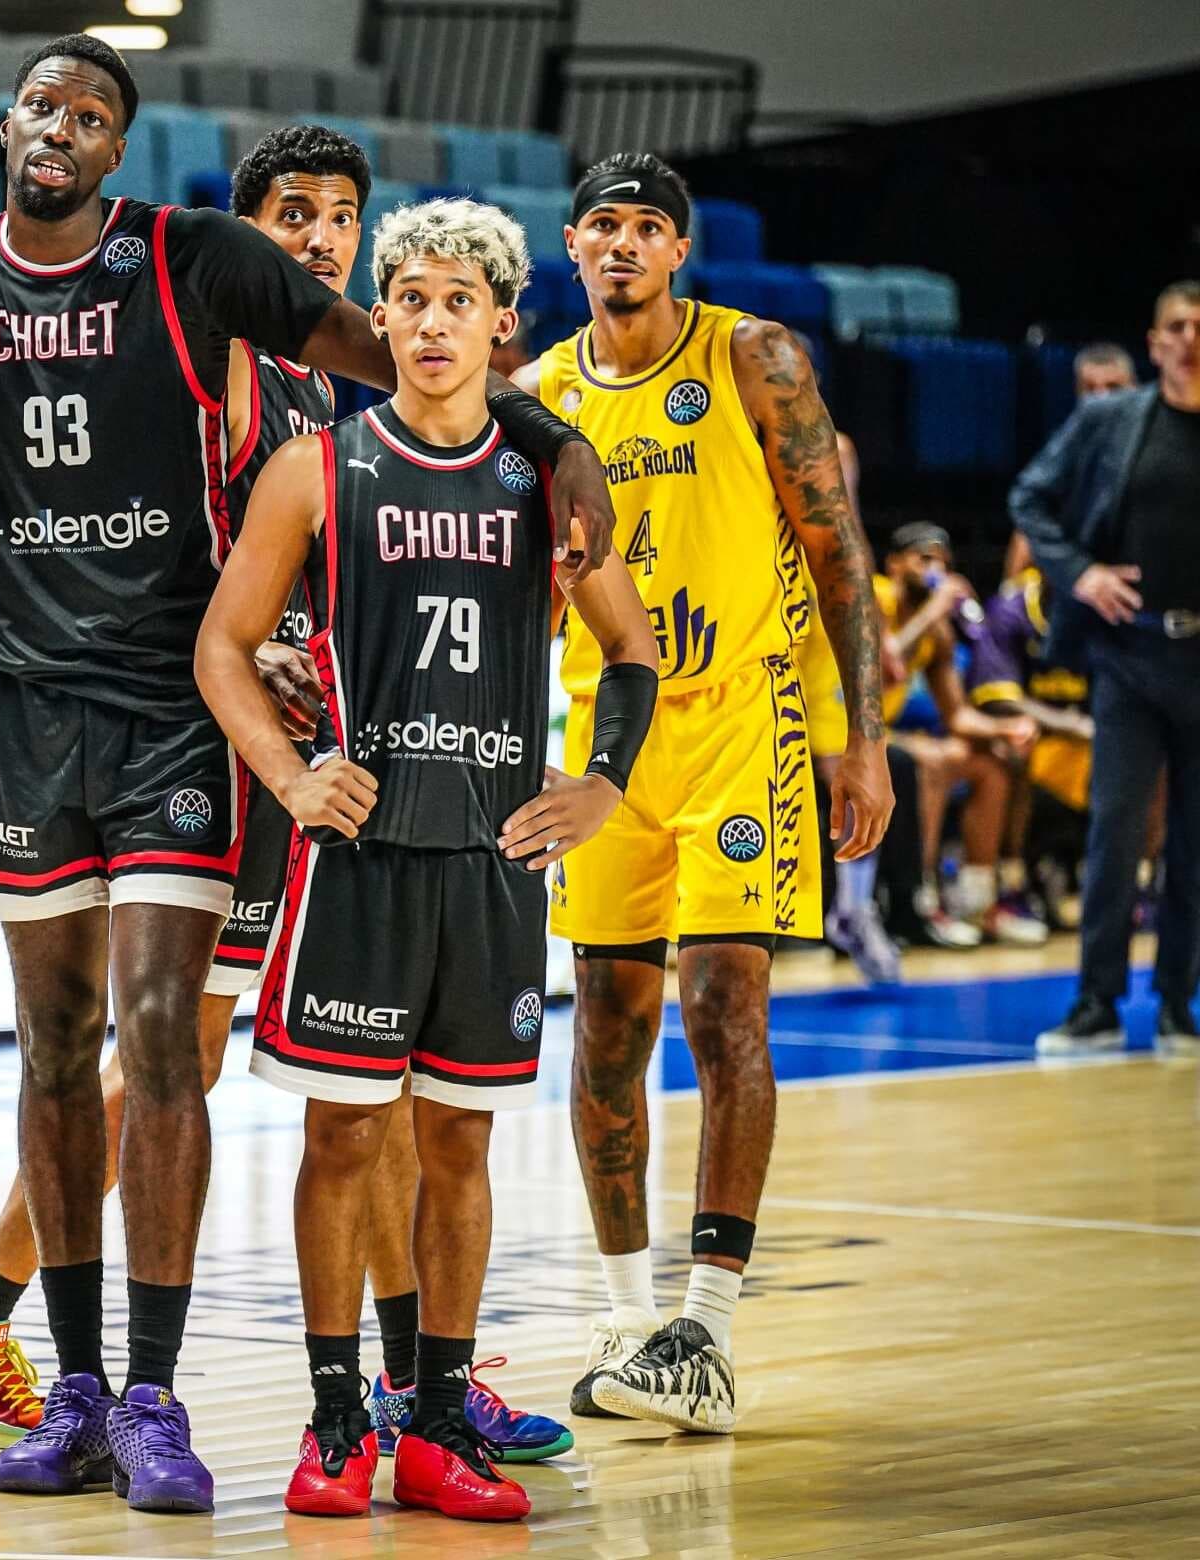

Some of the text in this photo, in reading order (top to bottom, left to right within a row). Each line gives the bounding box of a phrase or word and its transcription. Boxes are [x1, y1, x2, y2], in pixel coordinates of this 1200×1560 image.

[23, 393, 91, 468] 93
[642, 440, 697, 476] HOLON
[10, 501, 170, 549] solengie
[377, 505, 518, 567] CHOLET
[625, 510, 658, 576] 4
[415, 595, 480, 673] 79
[386, 713, 523, 769] solengie
[2, 846, 39, 859] Façades
[229, 900, 273, 921] LLET
[238, 922, 271, 934] Façade
[301, 1016, 405, 1041] Fenêtres et Façades
[303, 993, 409, 1029] MILLET
